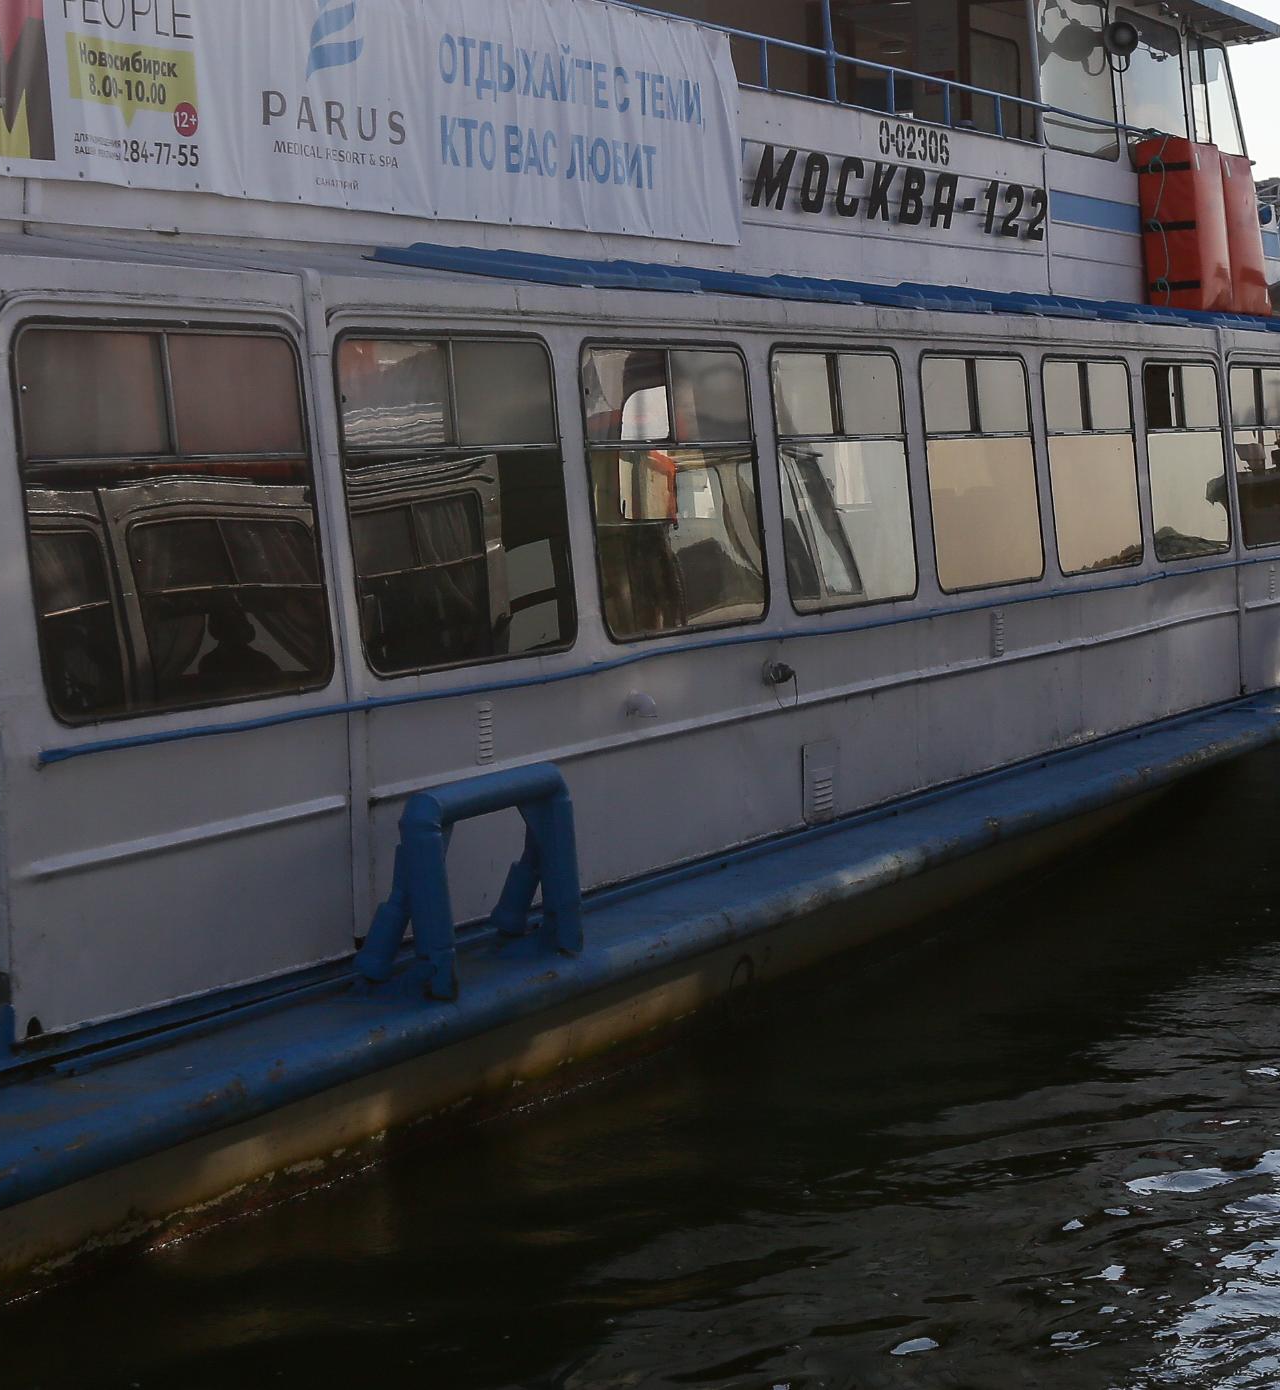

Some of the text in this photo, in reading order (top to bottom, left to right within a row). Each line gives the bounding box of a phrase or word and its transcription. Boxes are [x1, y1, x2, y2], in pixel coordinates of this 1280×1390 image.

[78, 41, 179, 80] Новосибирск
[438, 32, 609, 109] ОТДЫХАЙТЕ
[613, 66, 631, 113] С
[88, 73, 168, 105] 8.00-10.00
[174, 111, 197, 128] 12+
[261, 90, 407, 146] PARUS
[123, 139, 200, 167] 284-77-55
[273, 140, 399, 169] MEDICAL RESORT & SPA
[439, 114, 658, 190] КТО ВАС ЛЮБИТ
[751, 144, 1048, 241] МОСКВА-122
